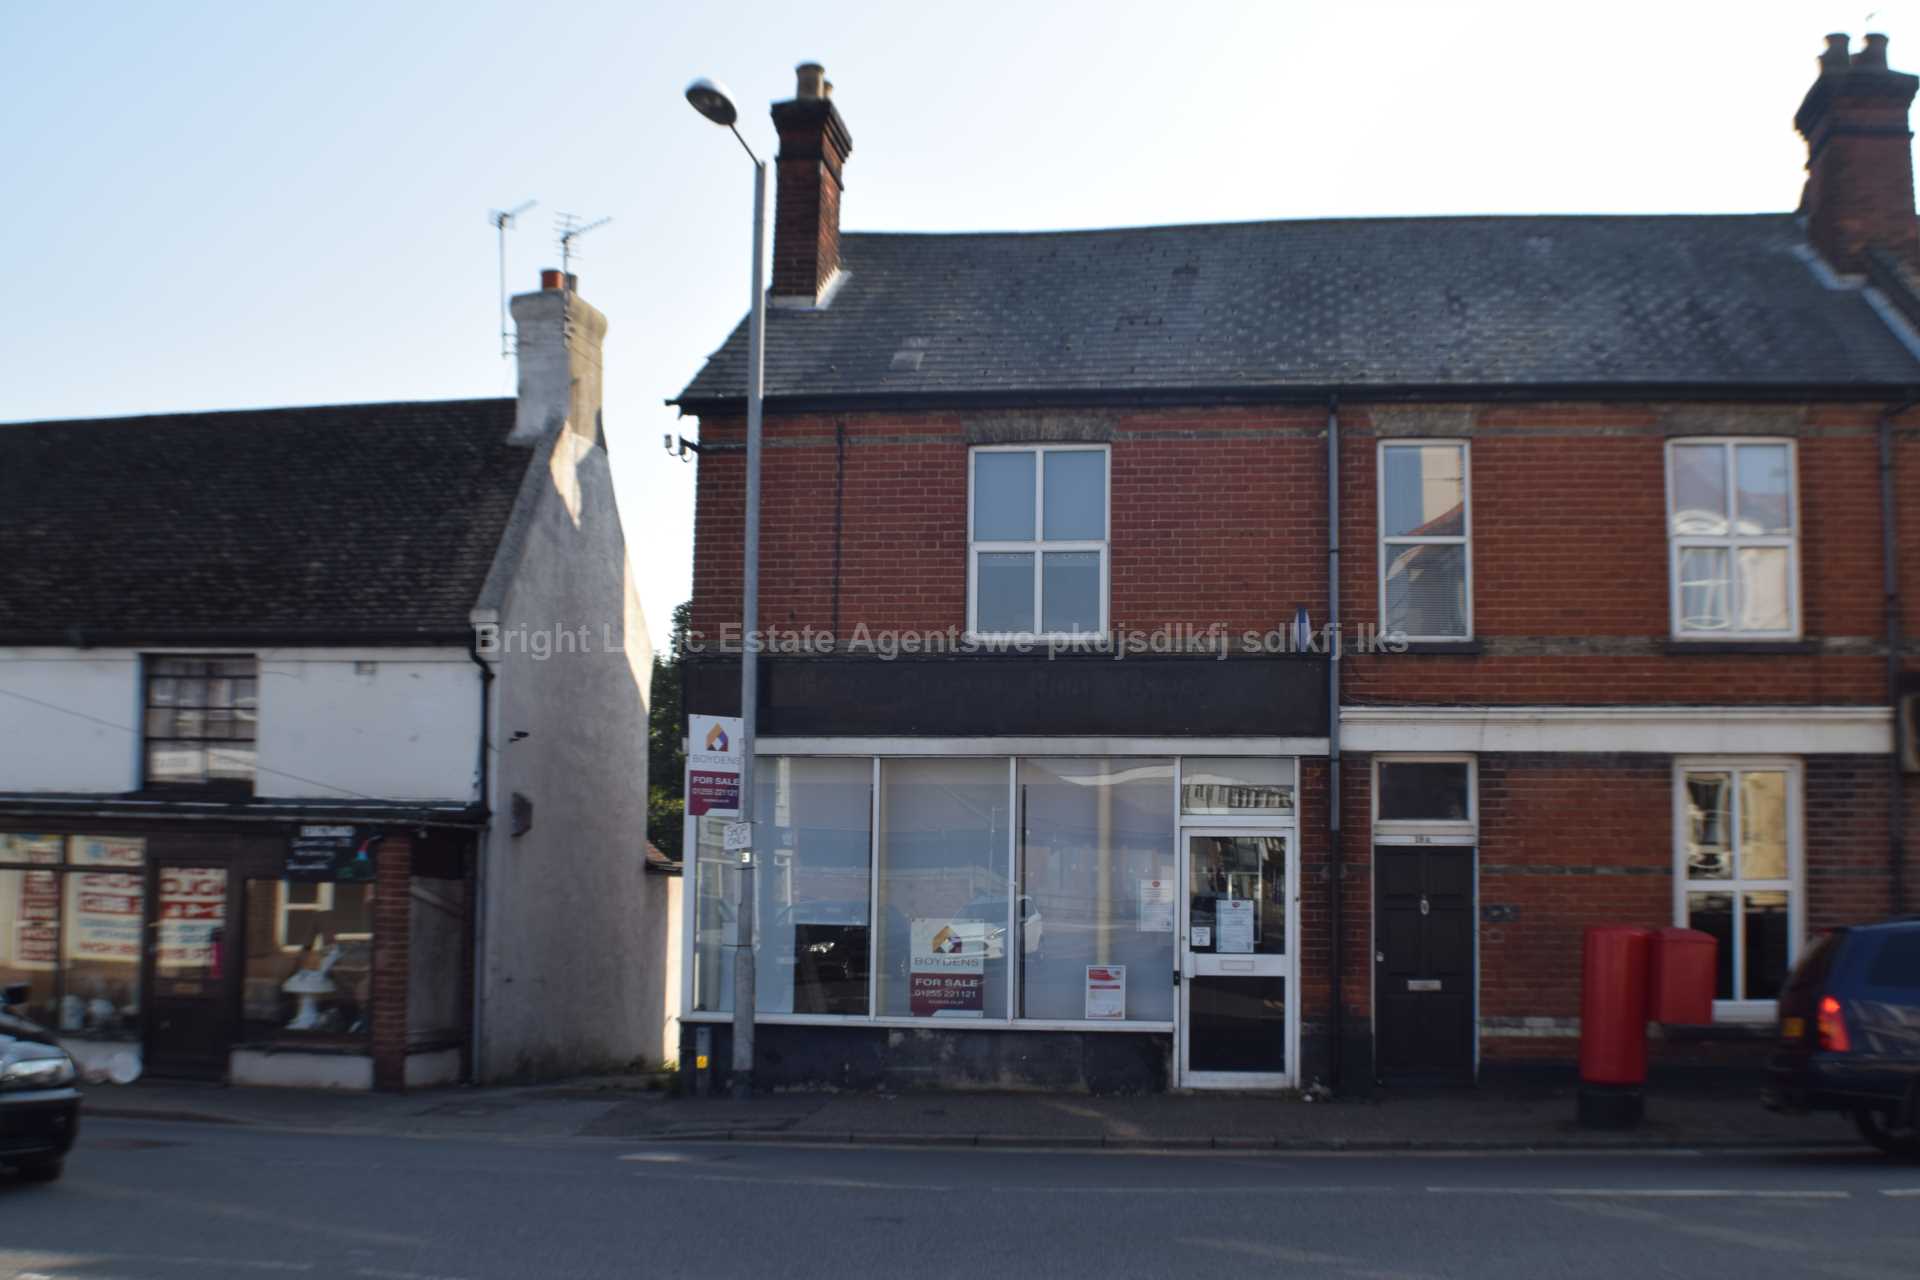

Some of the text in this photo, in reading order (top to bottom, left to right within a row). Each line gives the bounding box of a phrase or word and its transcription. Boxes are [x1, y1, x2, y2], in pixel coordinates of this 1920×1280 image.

[692, 776, 740, 786] FOR SALE
[915, 978, 979, 988] FOR SALE
